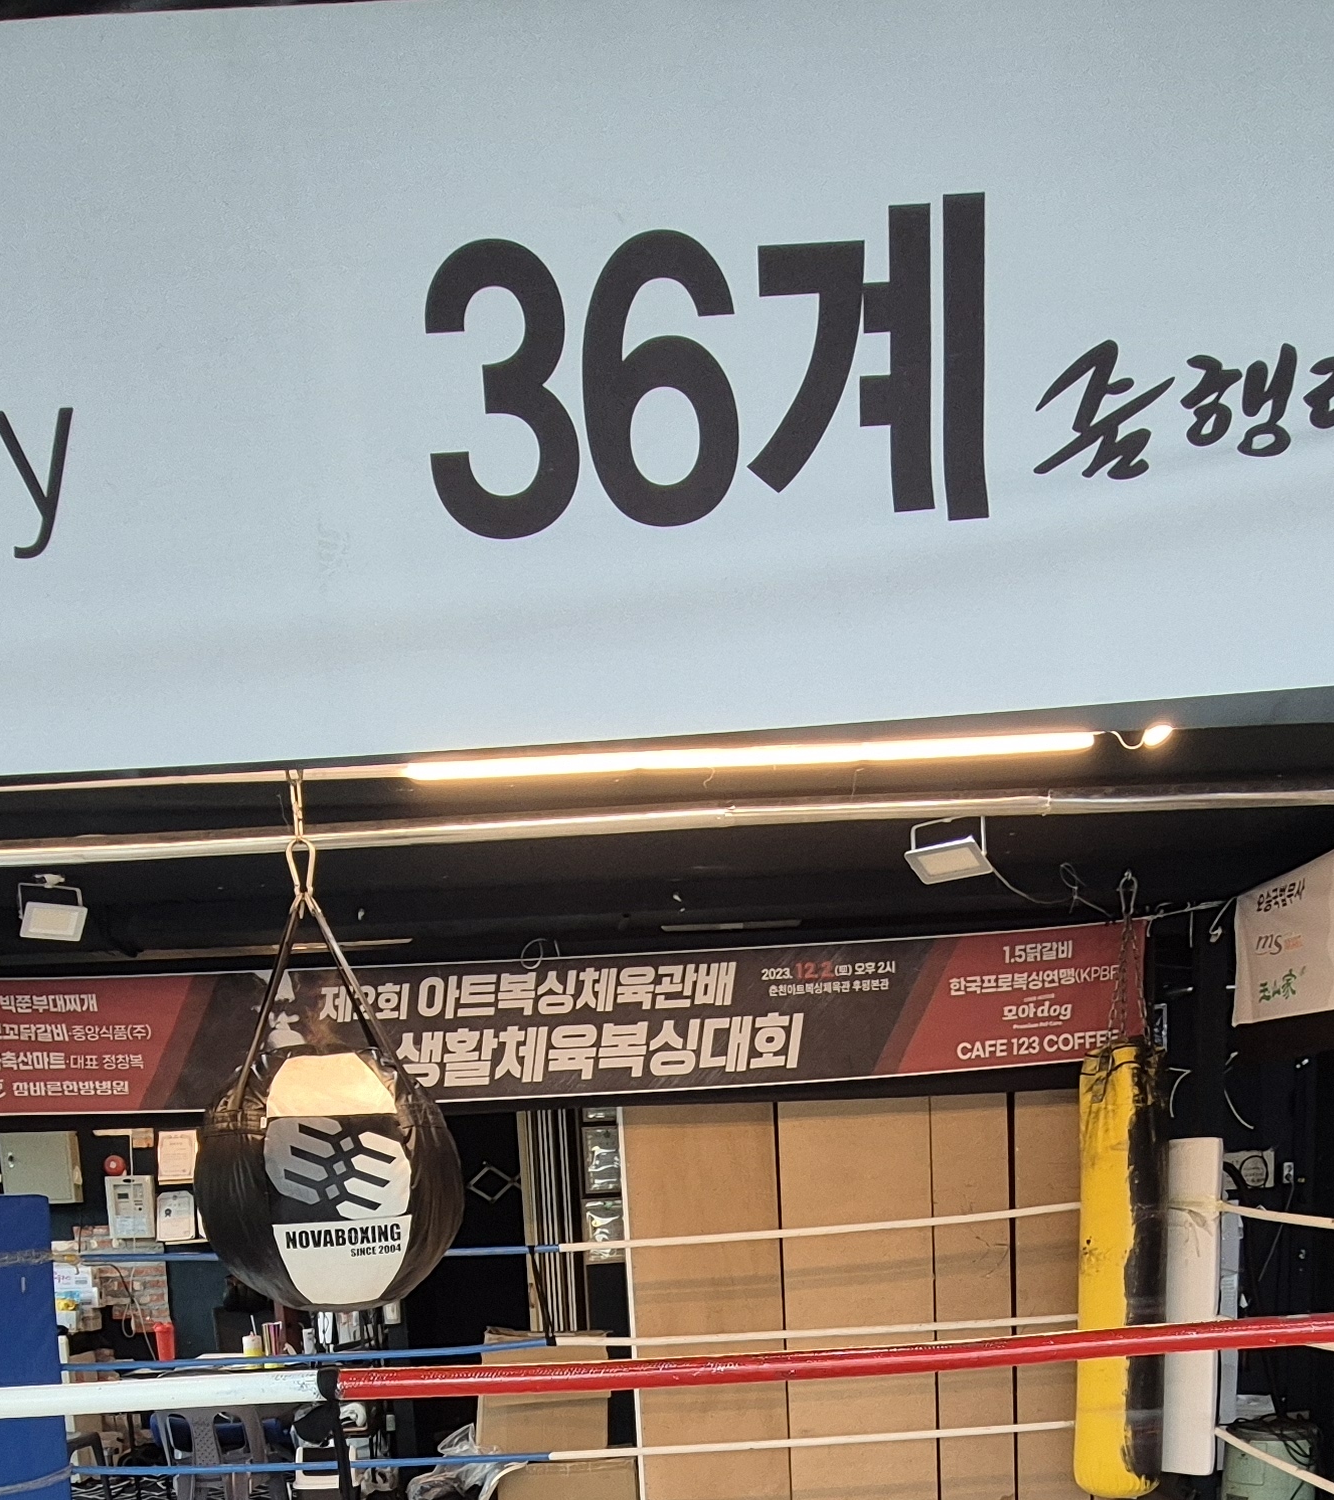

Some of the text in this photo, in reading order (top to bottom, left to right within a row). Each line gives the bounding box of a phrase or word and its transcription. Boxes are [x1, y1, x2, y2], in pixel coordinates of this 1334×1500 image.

[424, 191, 990, 539] 36계
[1002, 940, 1073, 964] 1.5닭갈비
[417, 961, 738, 1020] 아트복싱체육관배
[948, 964, 1121, 996] 한국프로복싱연맹(KPBF
[395, 1012, 805, 1088] 생활체육복싱대회
[956, 1038, 1008, 1060] CAFE
[1010, 1036, 1040, 1056] 123
[285, 1222, 402, 1250] NOVABOXING
[350, 1243, 402, 1258] SINCE 2004
